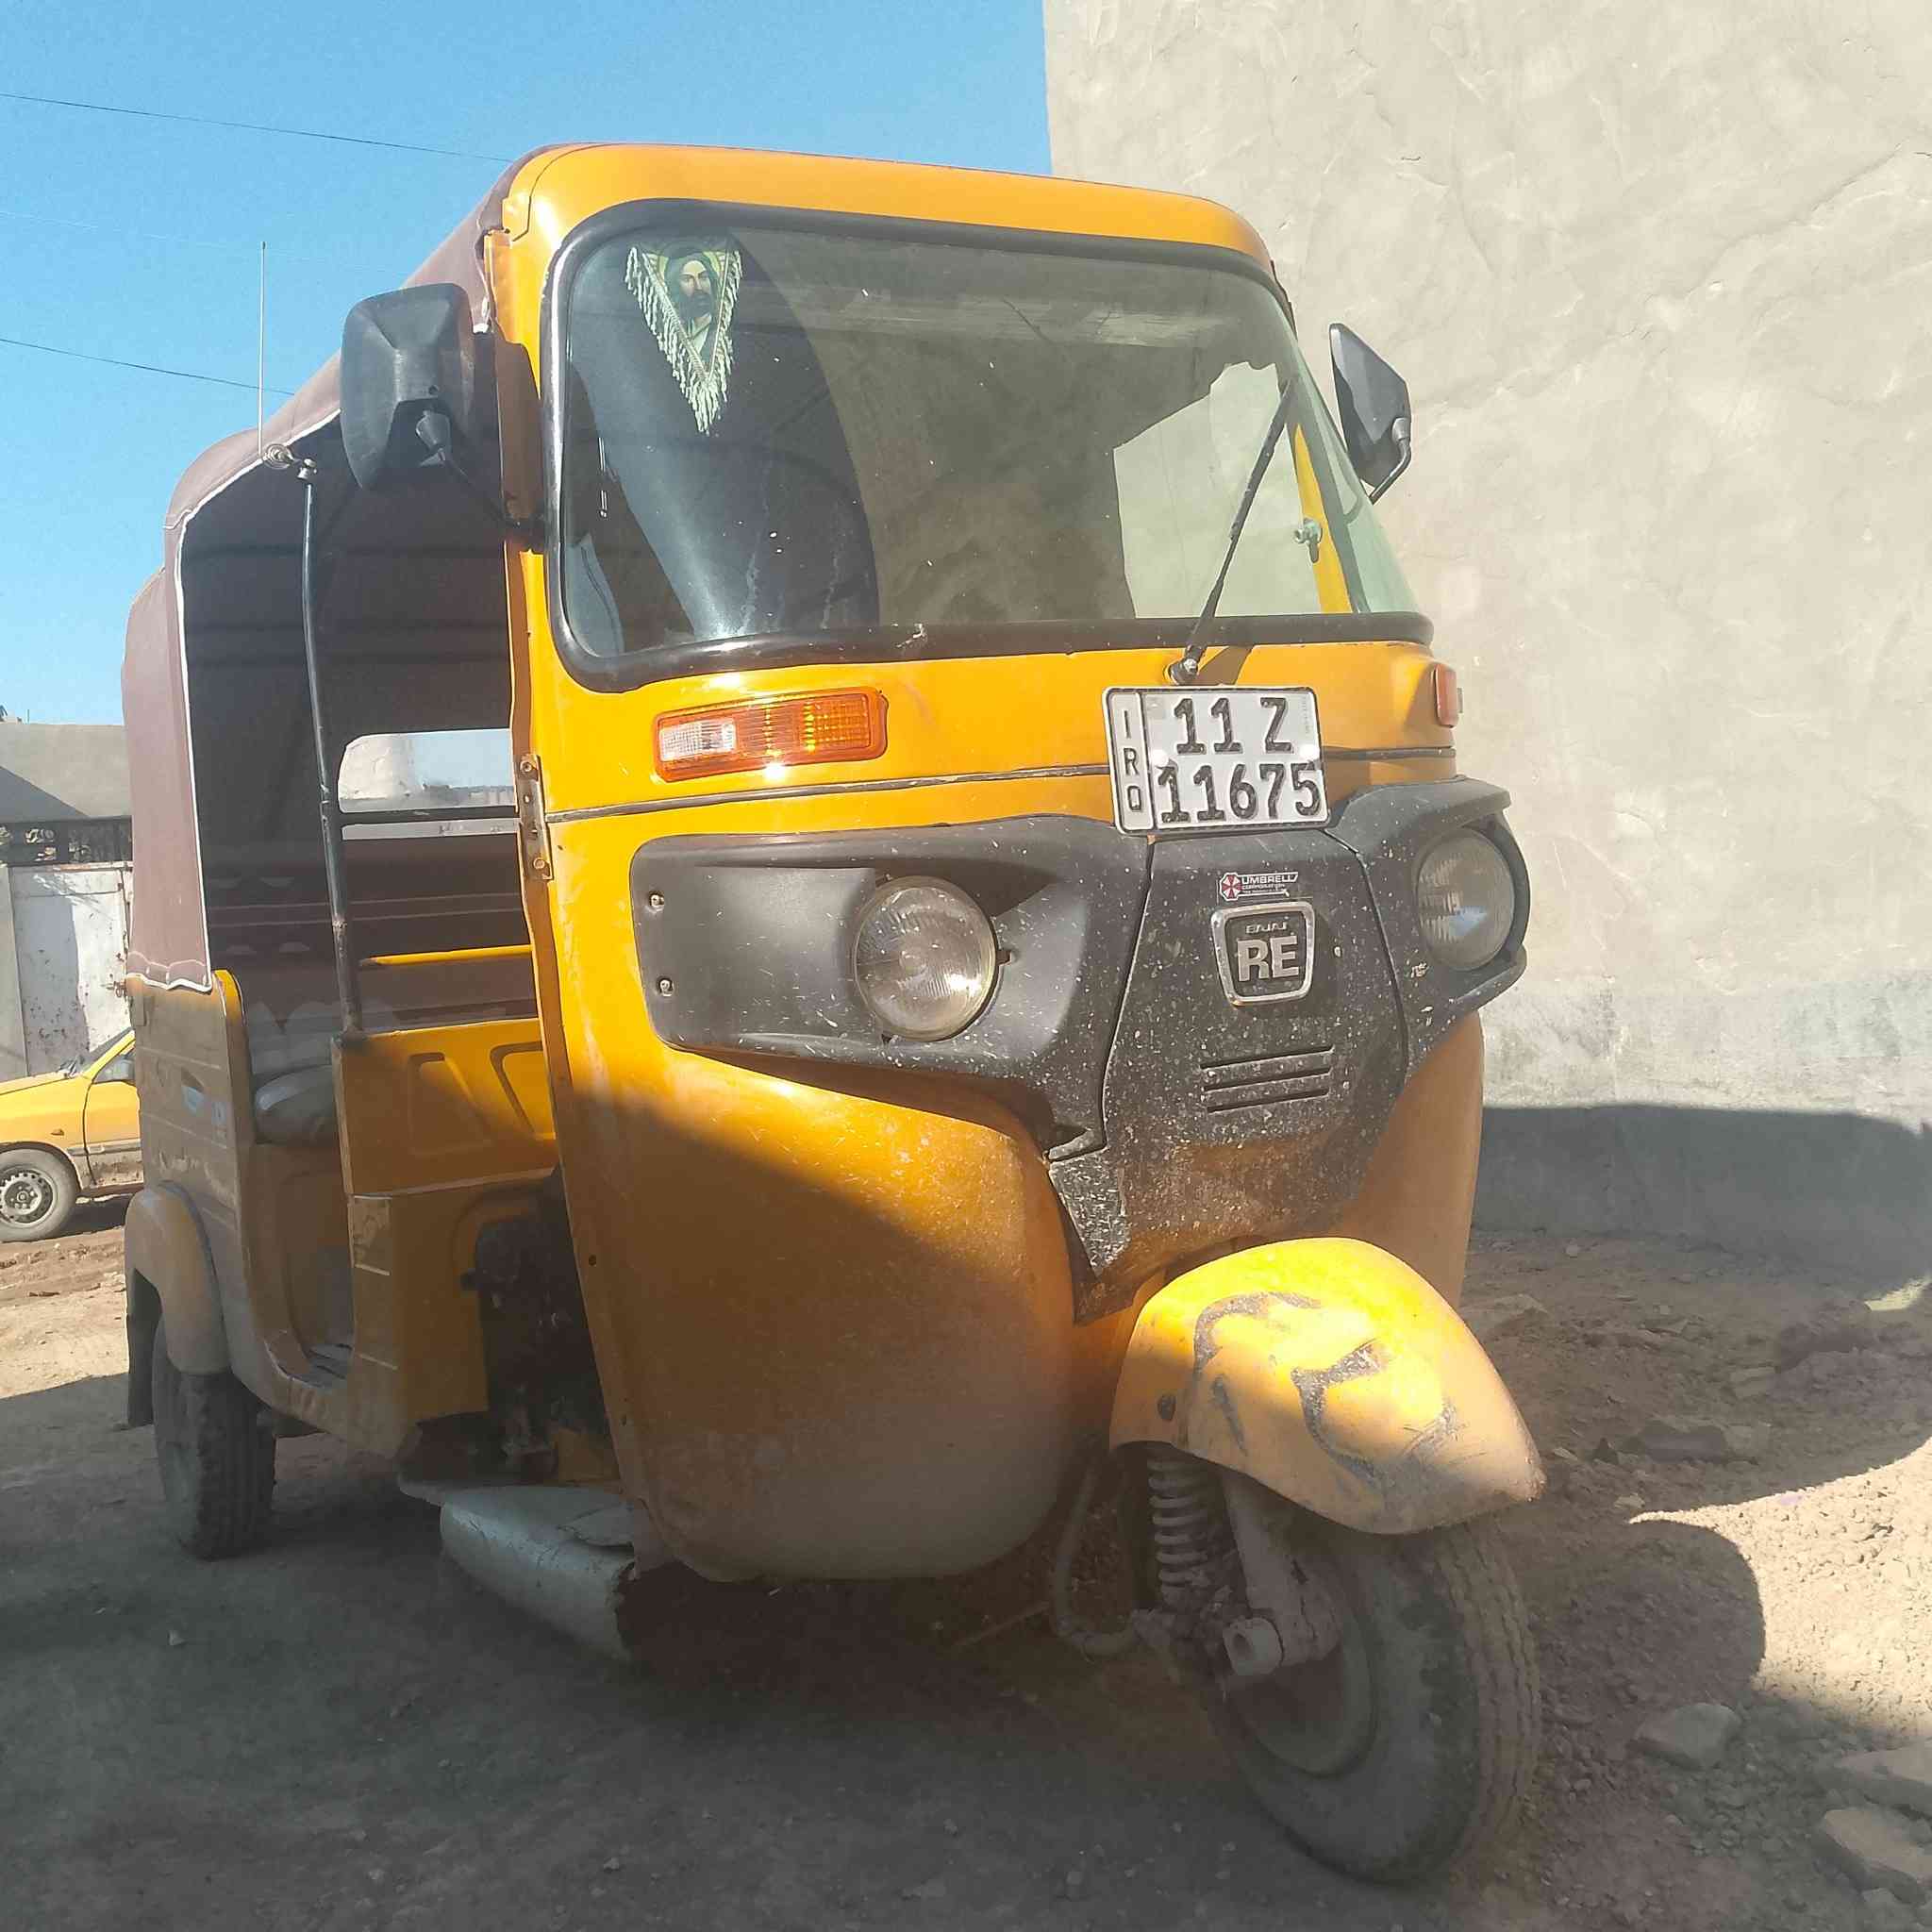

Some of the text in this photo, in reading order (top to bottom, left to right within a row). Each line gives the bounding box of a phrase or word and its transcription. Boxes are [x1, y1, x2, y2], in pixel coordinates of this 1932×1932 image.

[1174, 697, 1243, 755] 11
[1259, 696, 1294, 754] Z
[1158, 762, 1322, 824] 11675
[1237, 935, 1300, 982] RE
